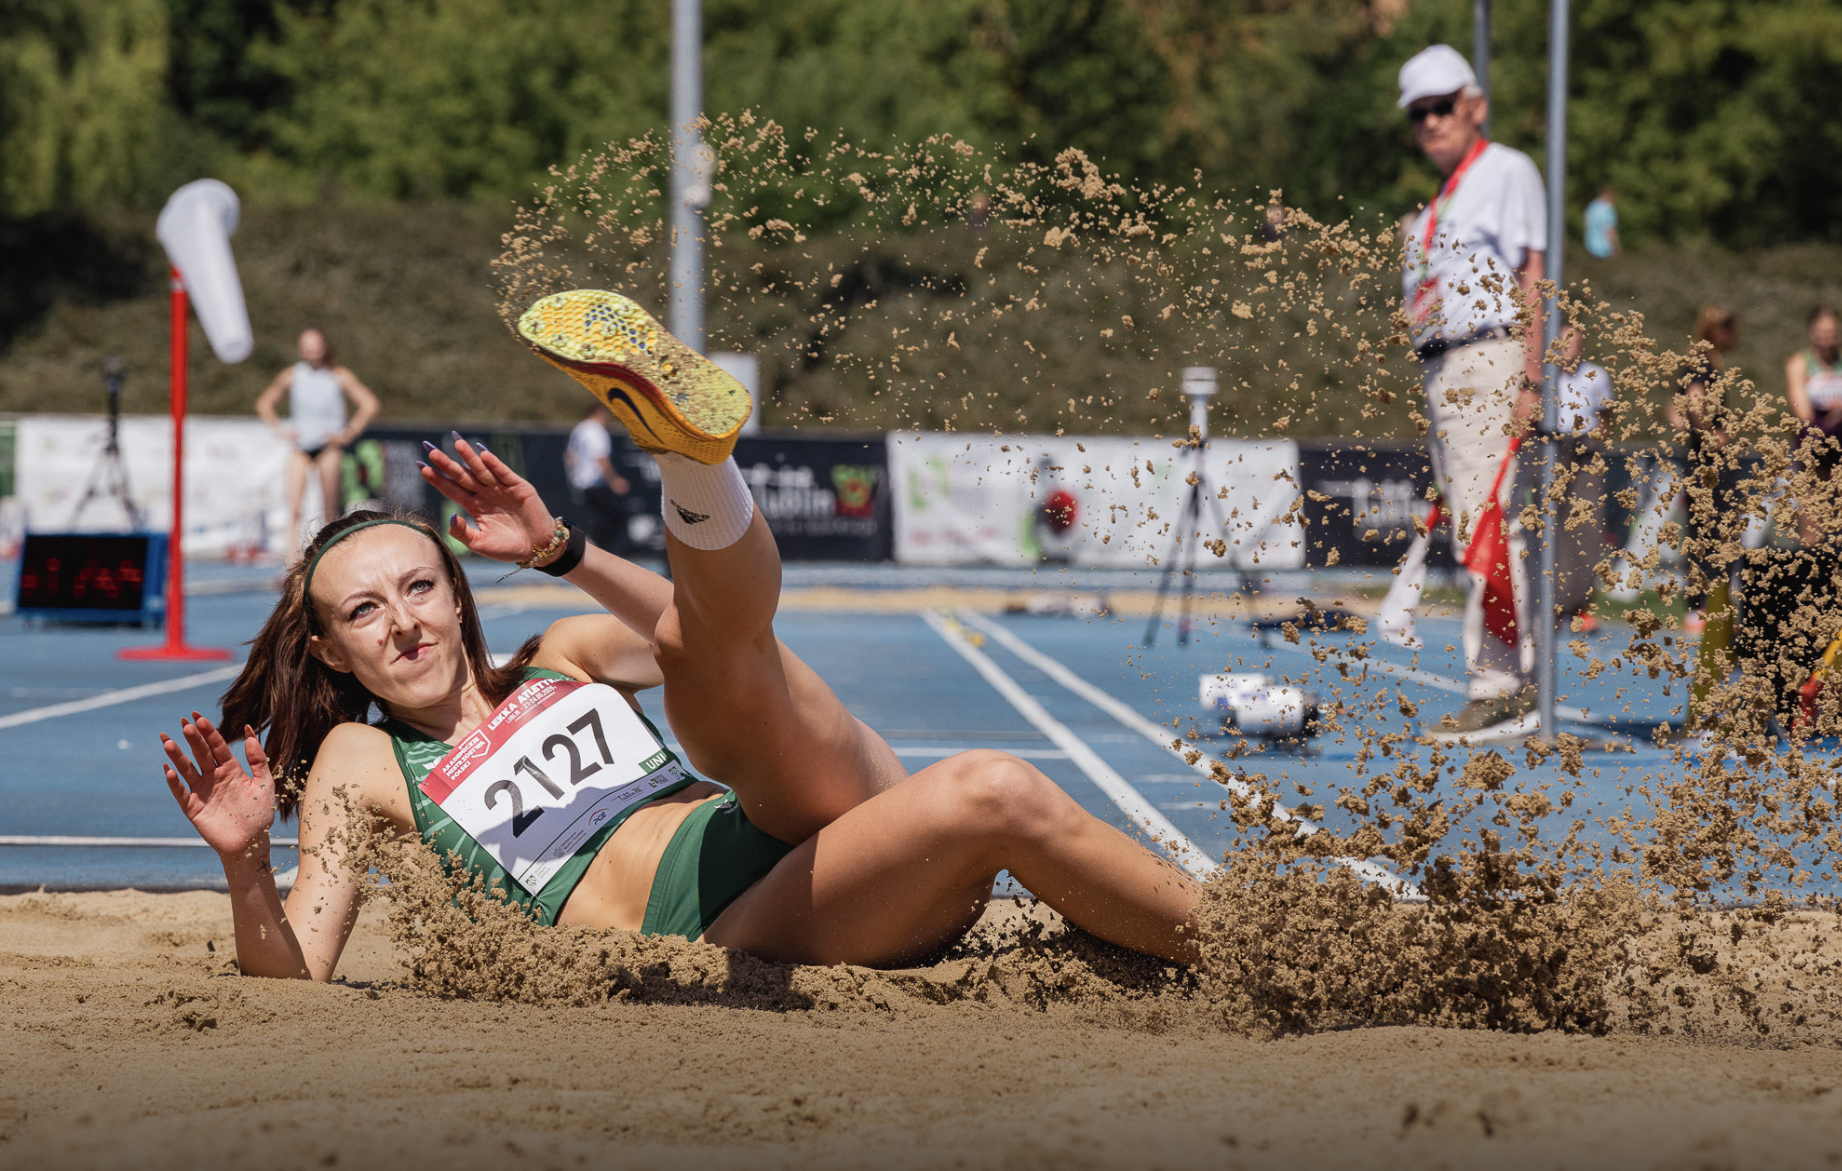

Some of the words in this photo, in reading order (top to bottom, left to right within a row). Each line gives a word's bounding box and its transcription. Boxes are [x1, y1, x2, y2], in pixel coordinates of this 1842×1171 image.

[487, 702, 518, 731] LEKKA
[505, 709, 521, 724] LUBLIN
[442, 736, 480, 774] AKADEMICKIE
[446, 740, 486, 777] MISTRZOSTWA
[645, 752, 667, 770] UNI
[450, 760, 471, 781] POLSKI
[484, 707, 615, 839] 2127
[593, 811, 608, 826] PGE
